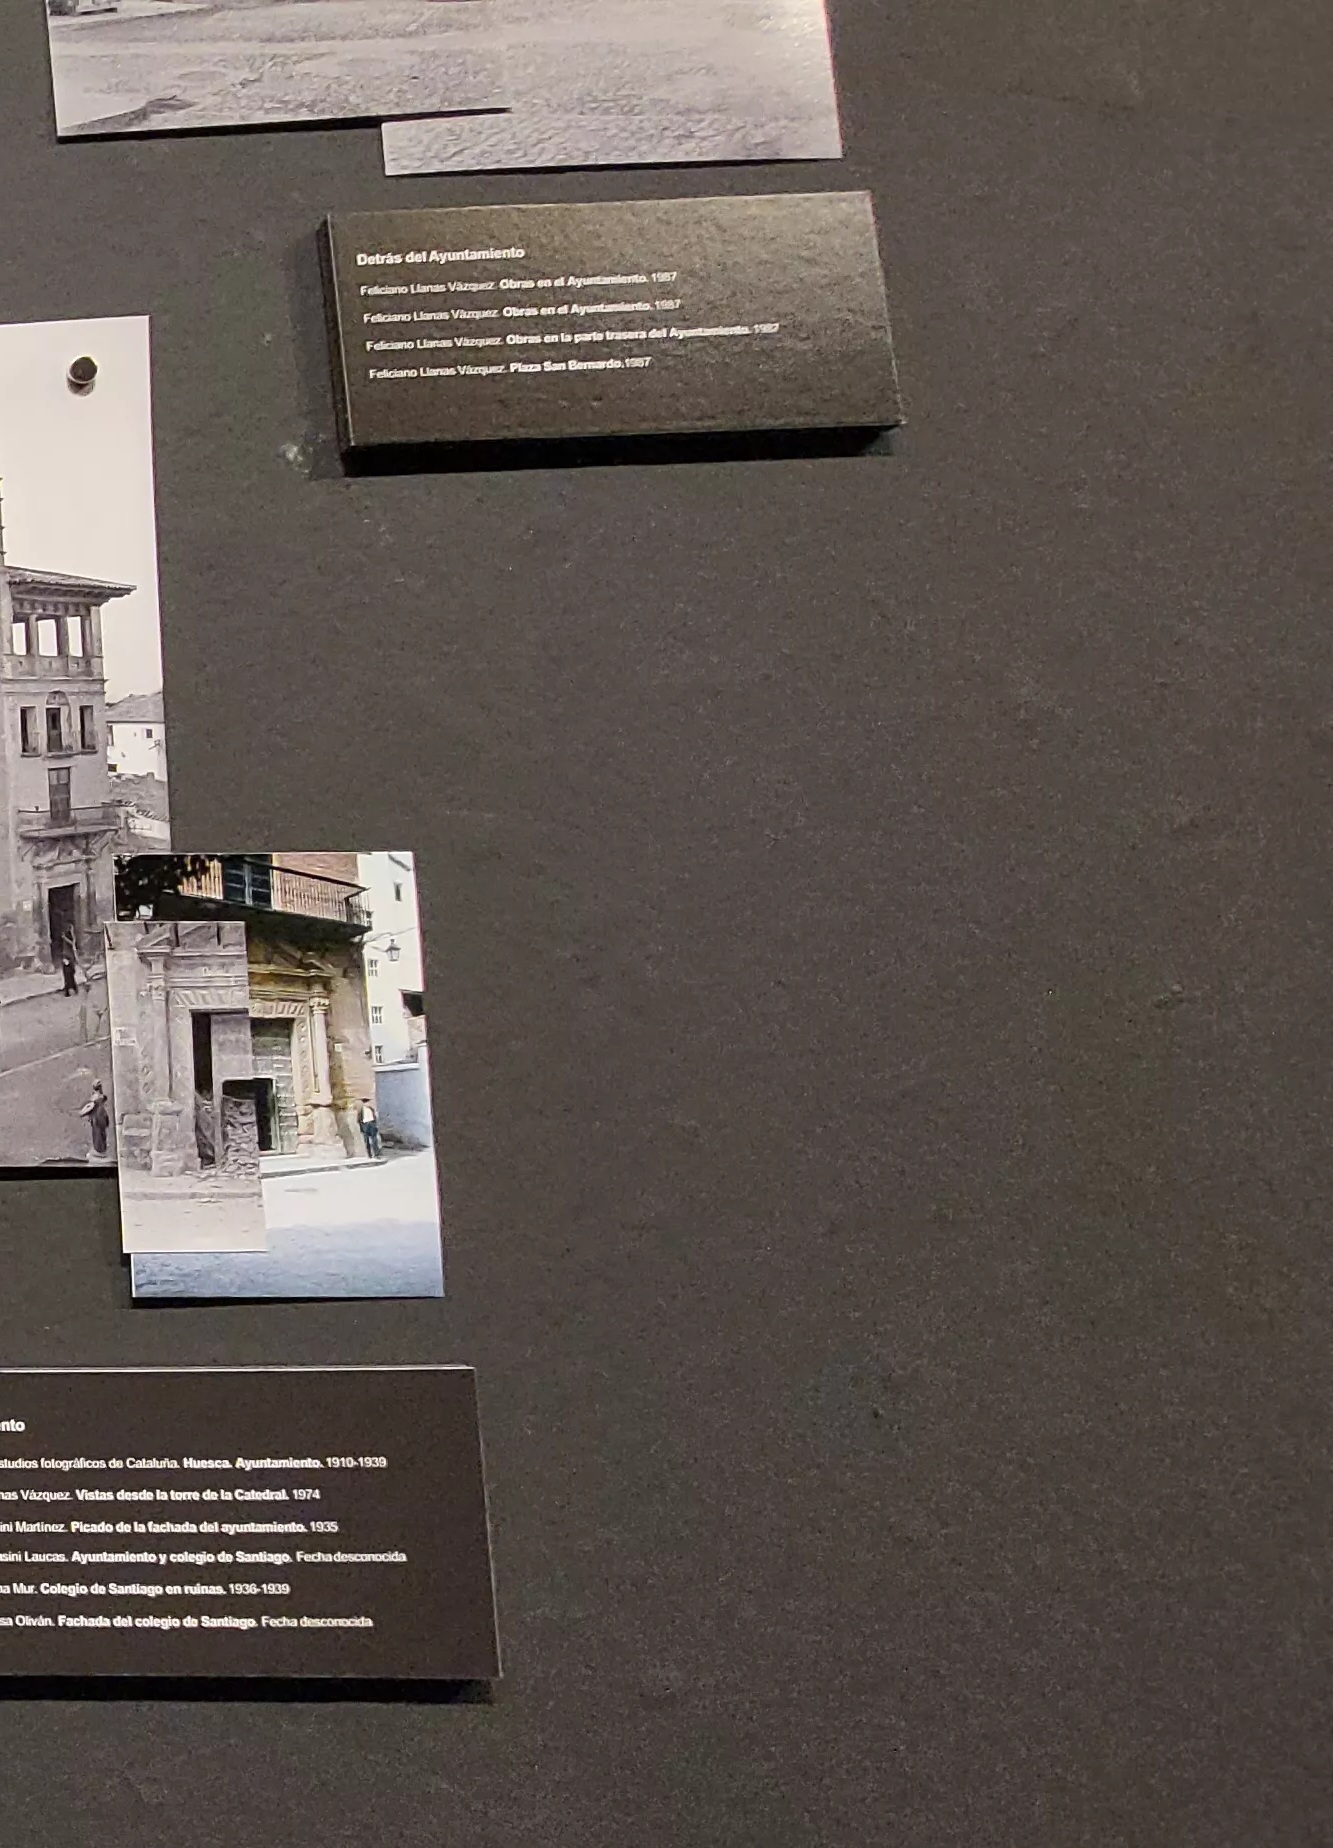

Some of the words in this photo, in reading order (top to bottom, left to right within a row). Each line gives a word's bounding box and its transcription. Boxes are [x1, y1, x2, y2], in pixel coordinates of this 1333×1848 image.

[41, 1457, 106, 1472] fotográficos
[108, 1457, 123, 1468] de
[183, 1457, 232, 1469] Huesca.
[235, 1457, 324, 1471] Ayuntamiento.
[326, 1456, 388, 1468] 1910-1939
[76, 1489, 114, 1501] Vistas
[117, 1489, 153, 1501] desde
[156, 1489, 168, 1501] la
[170, 1489, 200, 1501] torre
[202, 1488, 218, 1500] de
[220, 1488, 232, 1500] la
[234, 1488, 290, 1501] Catedral.
[292, 1488, 321, 1500] 1974
[71, 1521, 113, 1533] Picado
[116, 1520, 132, 1533] de
[134, 1521, 146, 1533] la
[148, 1520, 198, 1533] fachada
[200, 1521, 219, 1533] del
[220, 1521, 308, 1536] ayuntamiento.
[310, 1521, 338, 1532] 1935
[71, 1550, 157, 1564] Ayuntamiento
[159, 1553, 167, 1565] y
[170, 1551, 215, 1565] colegio
[217, 1551, 232, 1563] de
[236, 1551, 293, 1564] Santiago.
[13, 1582, 38, 1594] Mur.
[40, 1582, 88, 1597] Colegio
[91, 1582, 106, 1594] de
[108, 1582, 163, 1597] Santiago
[166, 1585, 181, 1595] en
[184, 1583, 227, 1595] ruinas.
[229, 1582, 290, 1595] 1936-1939
[58, 1614, 110, 1627] Fachada
[113, 1614, 132, 1627] del
[135, 1615, 181, 1630] colegio
[183, 1615, 198, 1627] de
[201, 1615, 258, 1629] Santiago.
